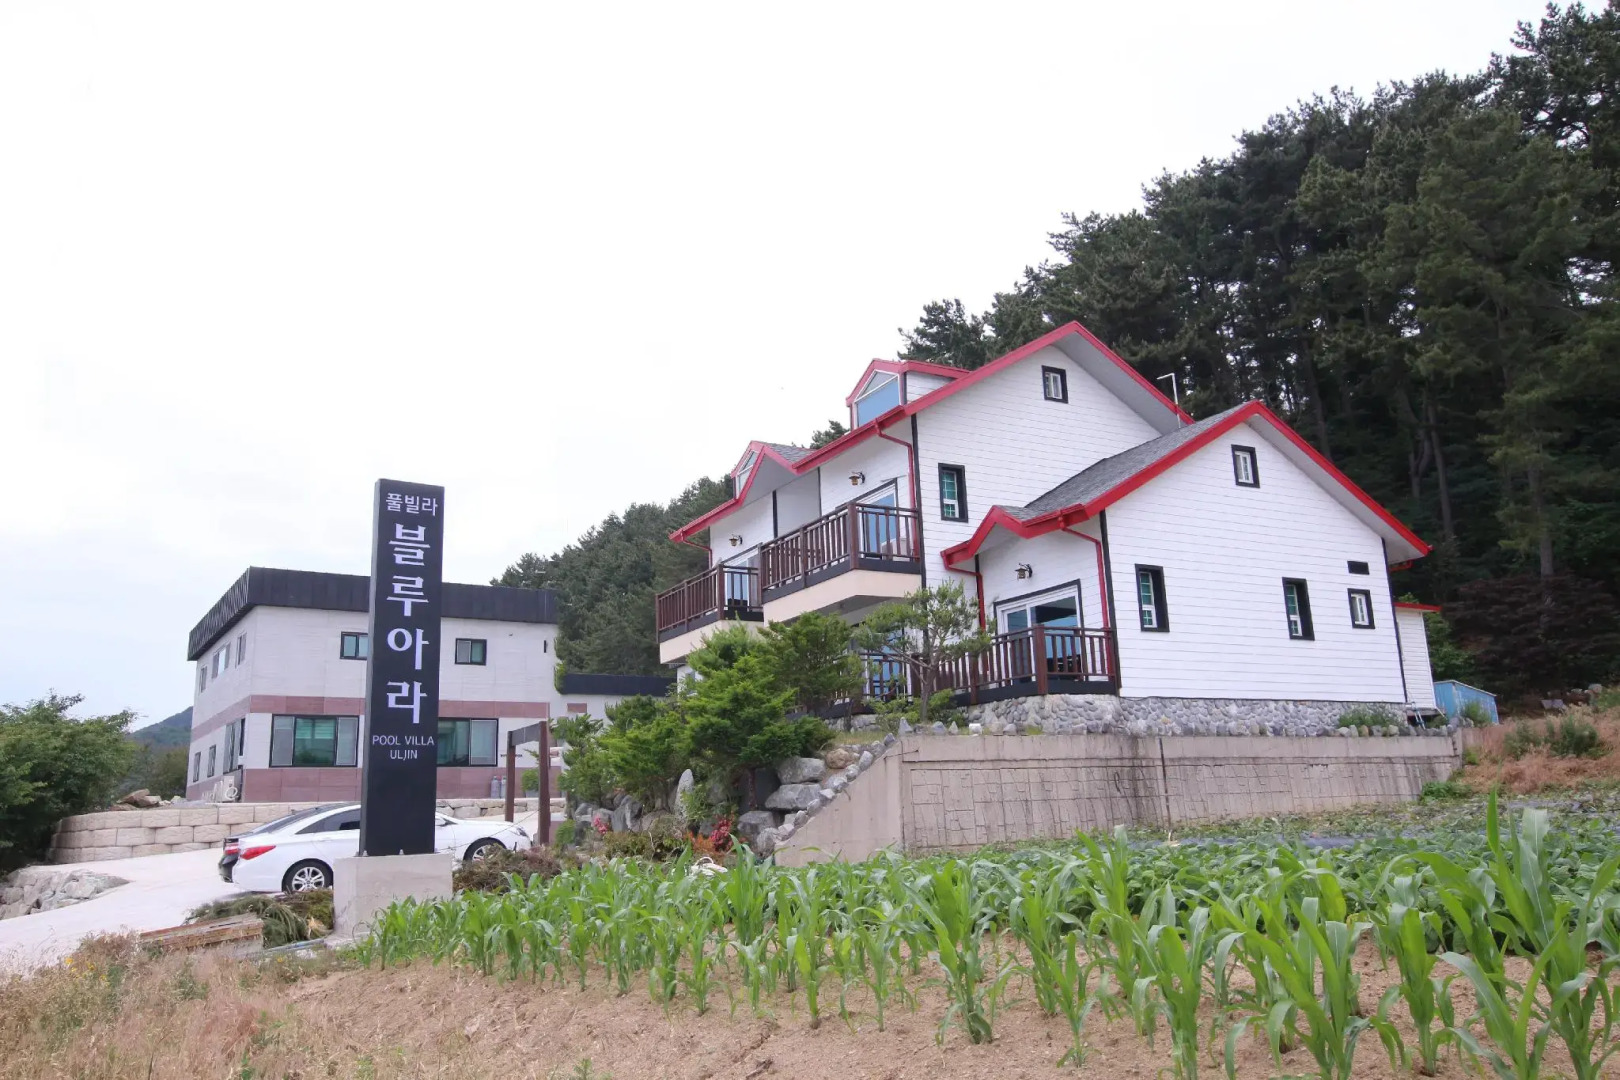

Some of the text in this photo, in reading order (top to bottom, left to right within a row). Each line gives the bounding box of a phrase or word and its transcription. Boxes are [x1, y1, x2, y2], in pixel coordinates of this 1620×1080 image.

[385, 492, 438, 516] 풀빌라
[386, 522, 431, 724] 블루아라
[372, 734, 435, 746] POOL VILLA
[389, 749, 418, 761] ULJIN
